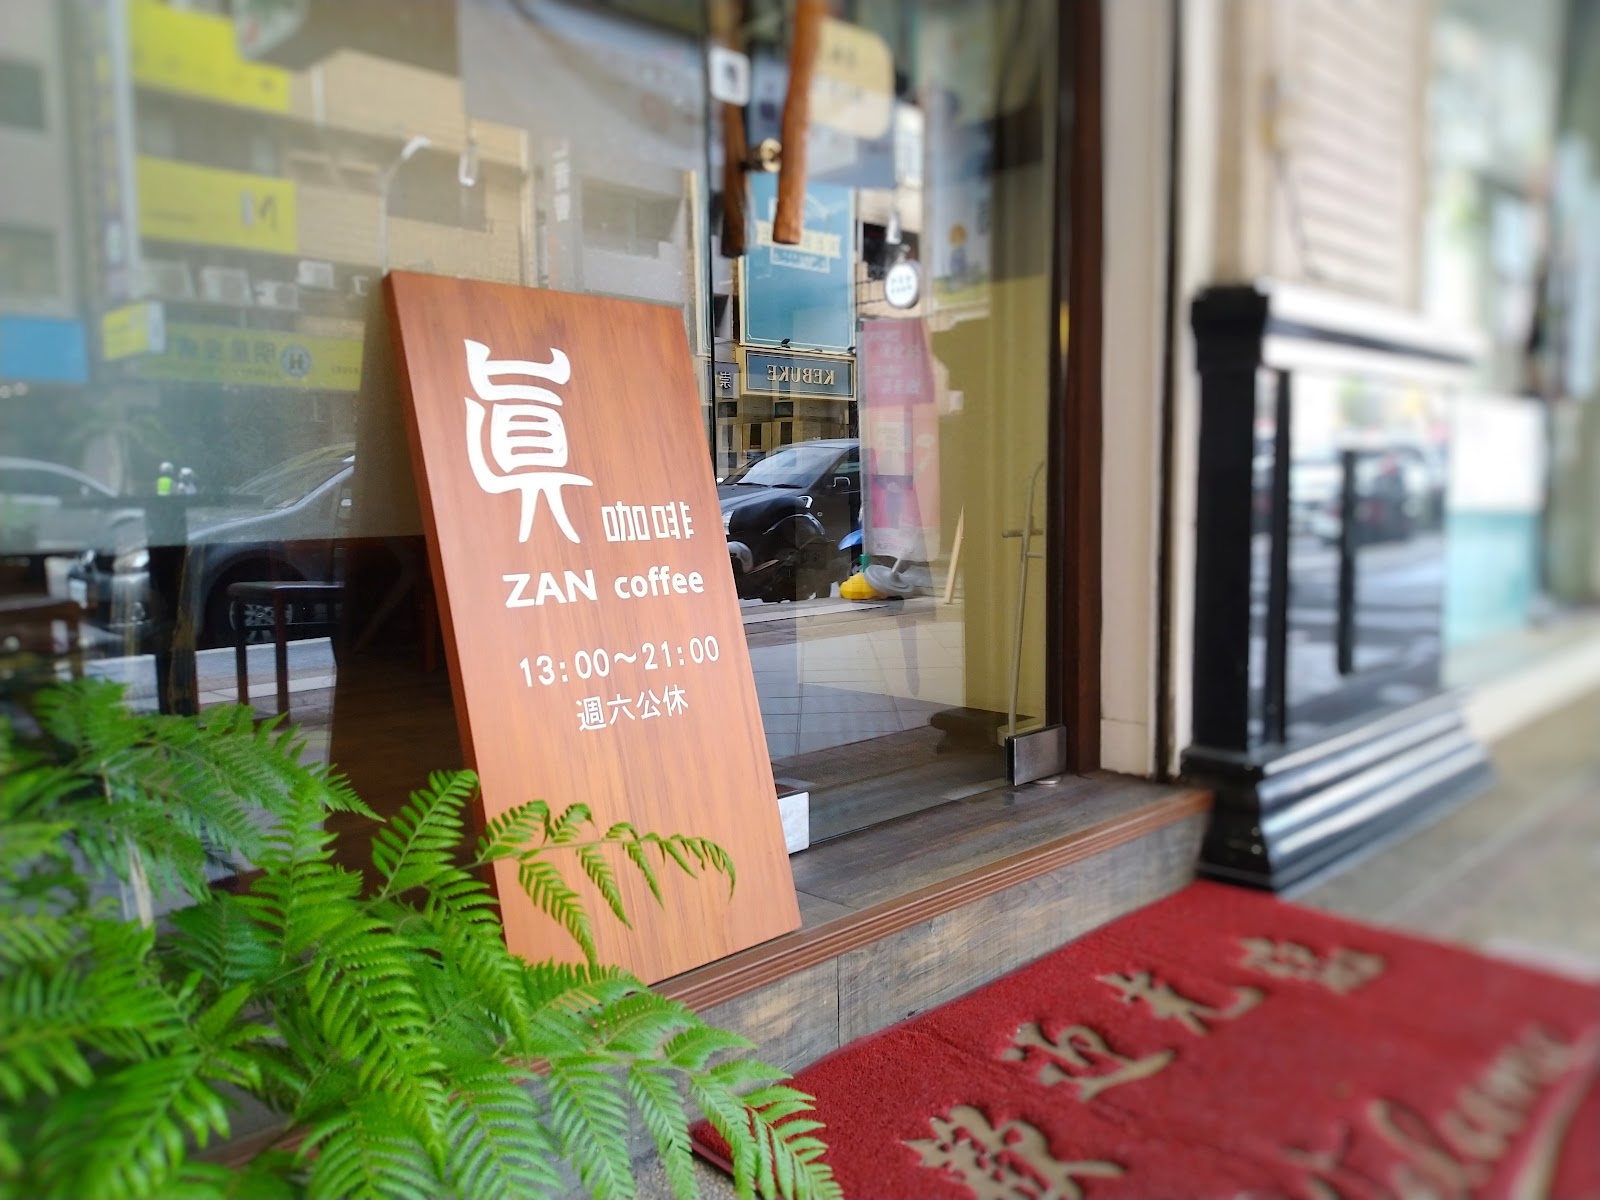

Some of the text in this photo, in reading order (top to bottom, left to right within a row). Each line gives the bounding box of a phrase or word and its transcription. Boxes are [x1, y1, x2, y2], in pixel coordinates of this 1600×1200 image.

[601, 501, 695, 542] 咖啡
[502, 566, 705, 609] ZAN coffee
[575, 684, 690, 732] 週六公休
